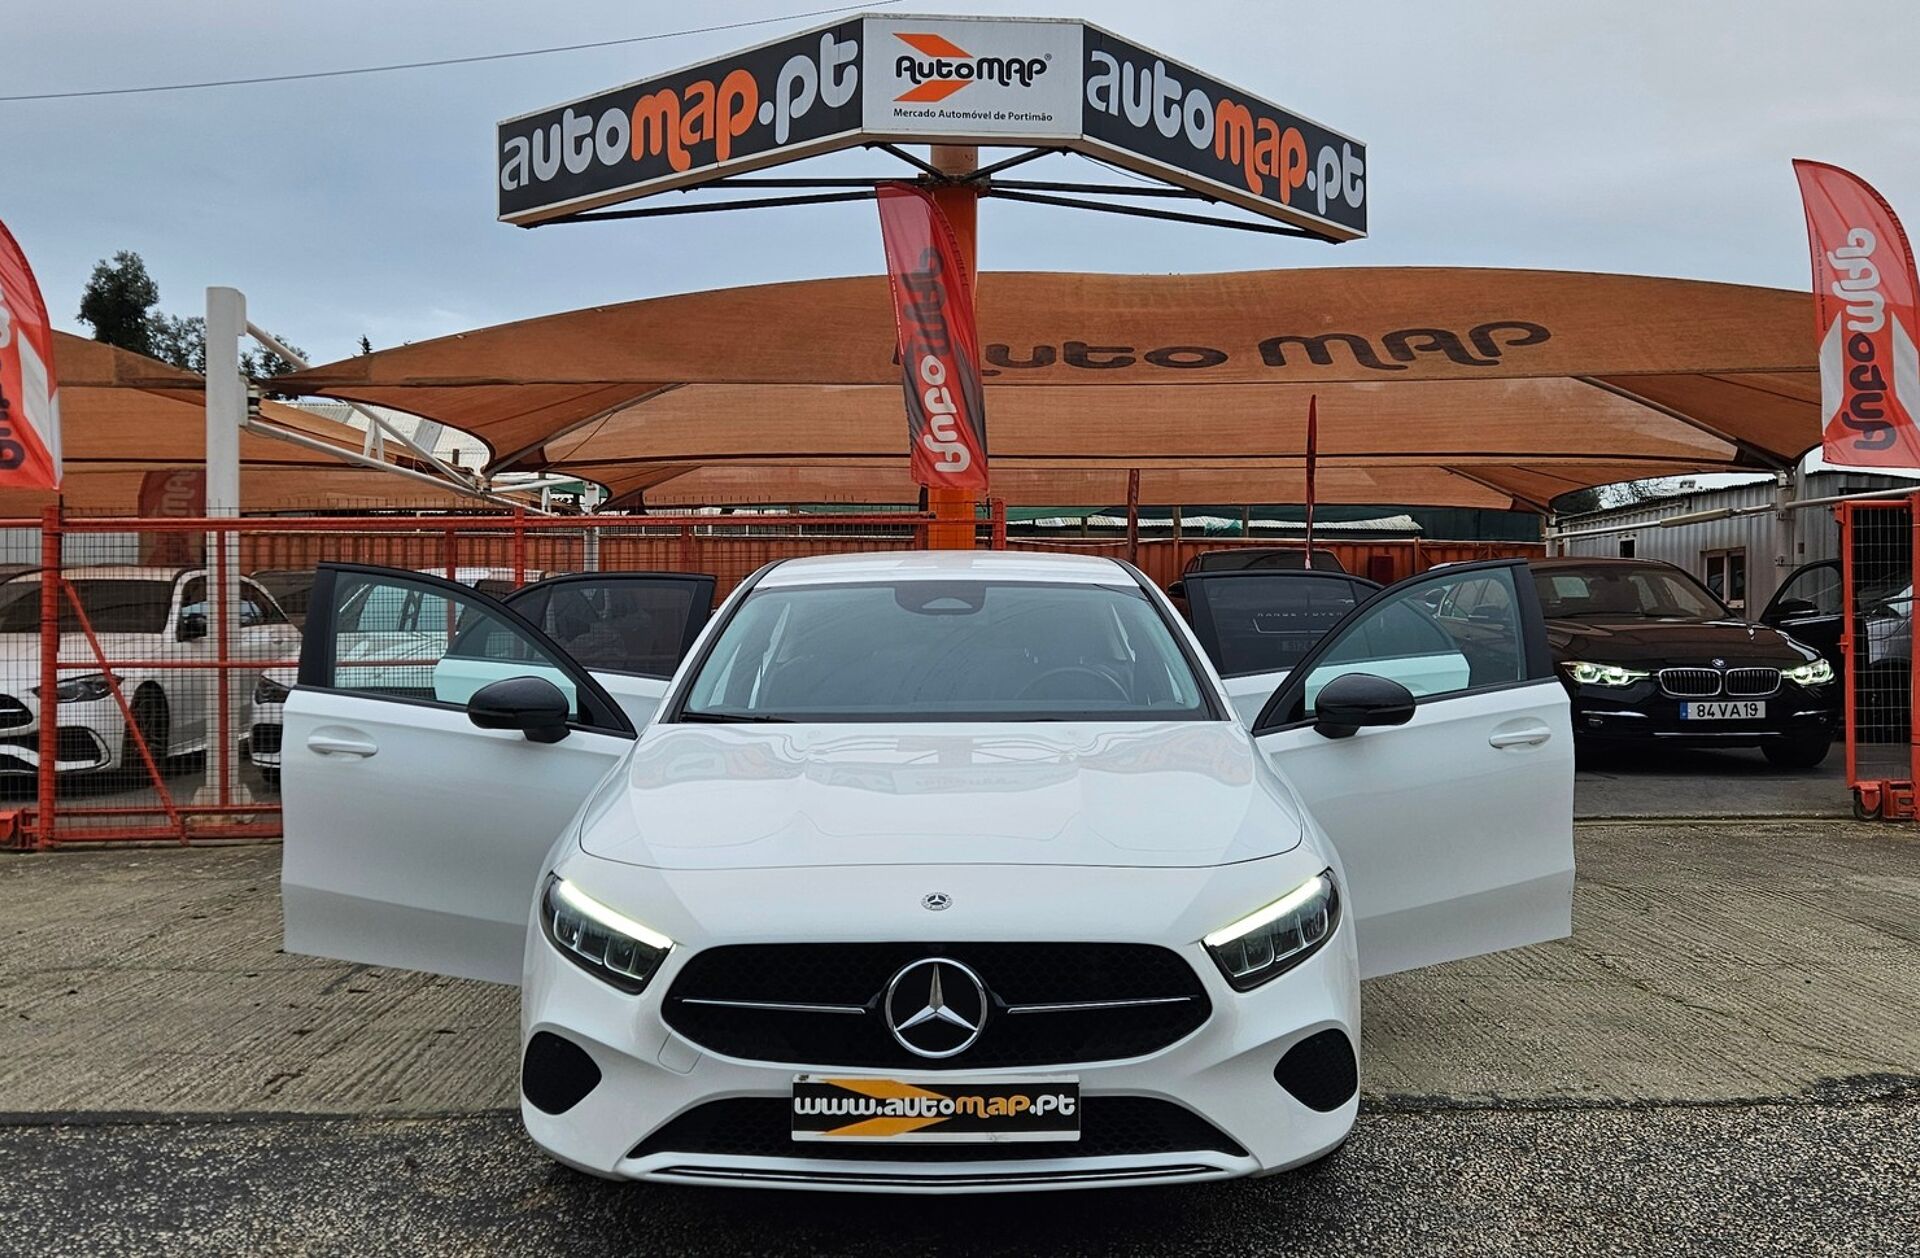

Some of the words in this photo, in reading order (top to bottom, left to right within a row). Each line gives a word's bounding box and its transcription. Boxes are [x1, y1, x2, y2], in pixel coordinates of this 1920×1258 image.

[500, 32, 859, 191] automap.pt
[893, 108, 936, 118] Mercado
[938, 109, 991, 120] Automóvel
[993, 110, 1006, 120] de
[1008, 111, 1053, 122] Portimão
[1086, 50, 1364, 215] automap.pt
[892, 341, 1229, 377] uto
[1258, 320, 1551, 370] MAP
[793, 1095, 1076, 1118] www.automap.pt
